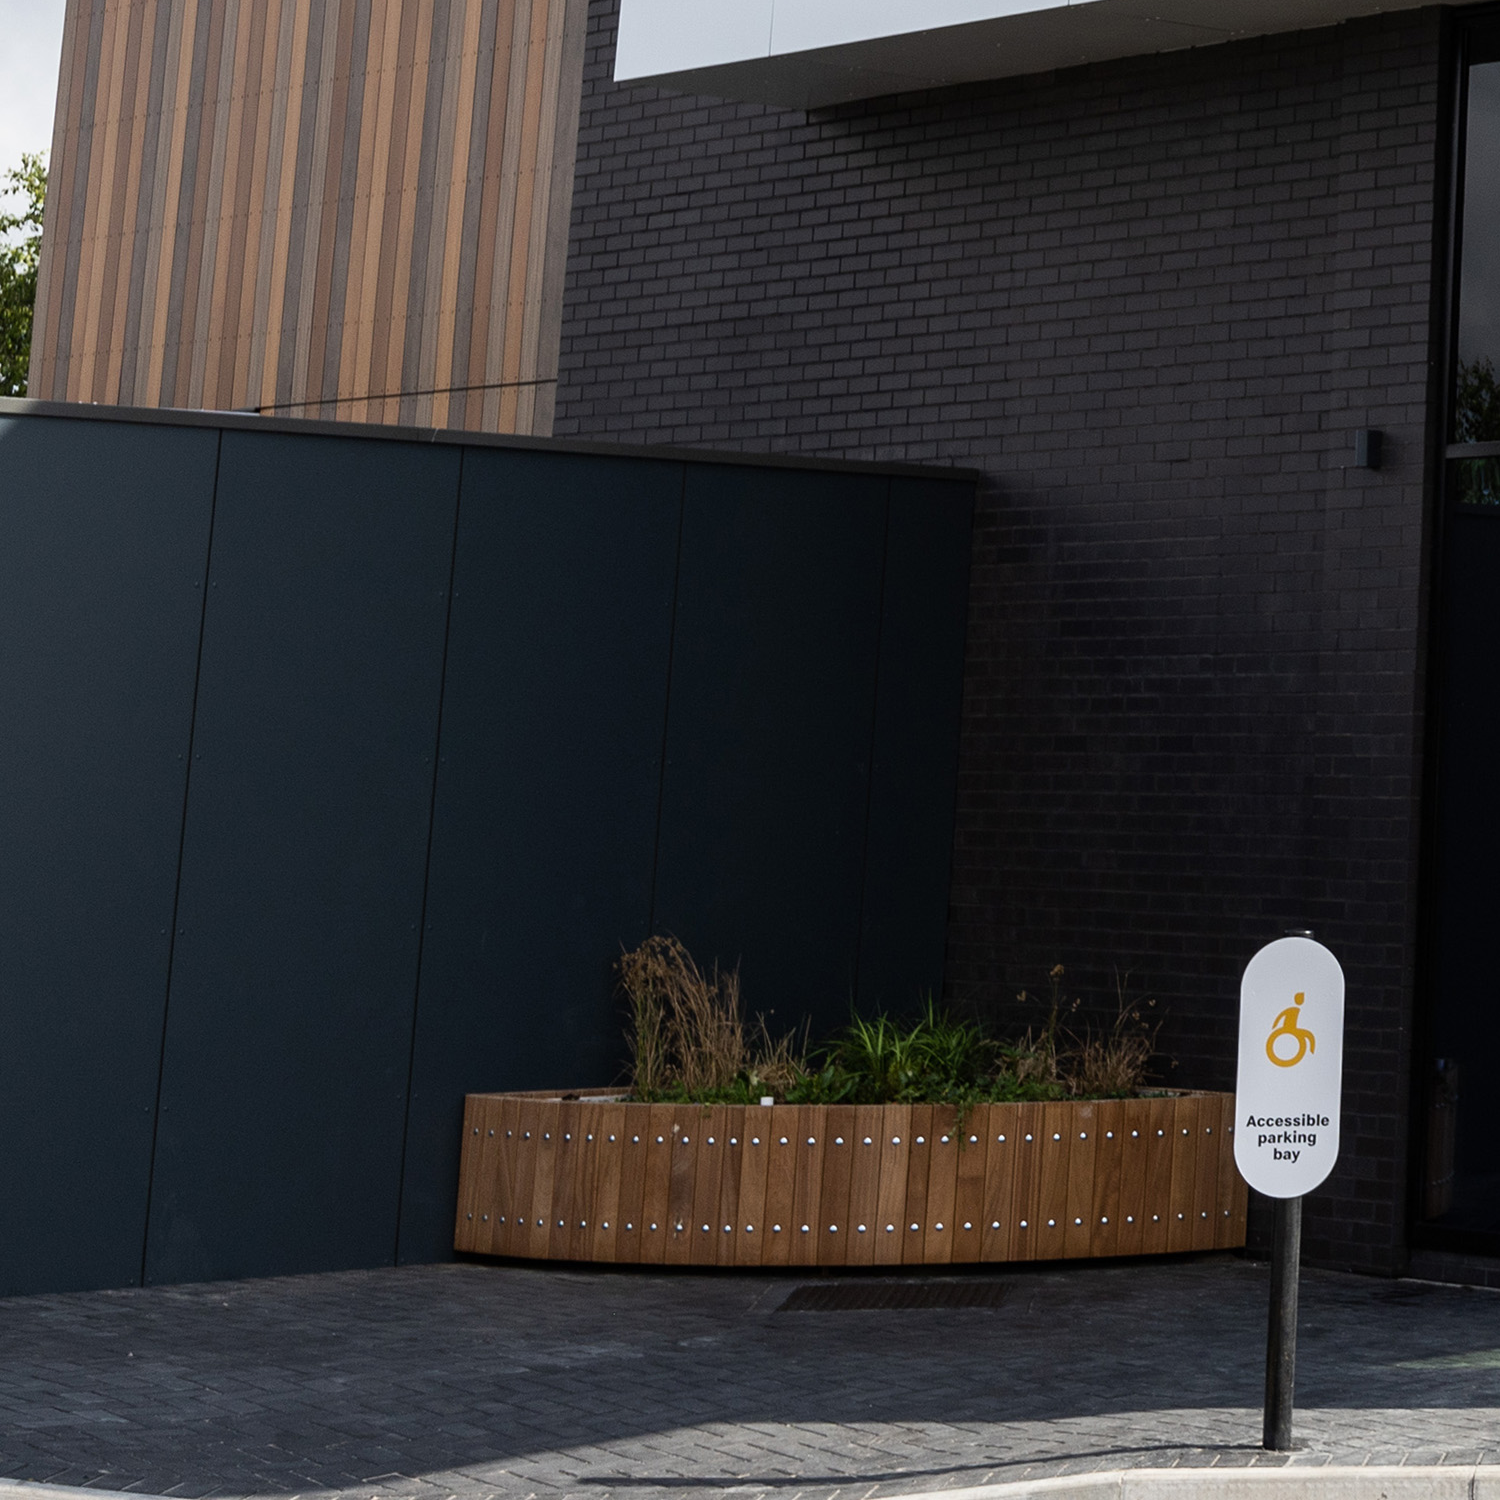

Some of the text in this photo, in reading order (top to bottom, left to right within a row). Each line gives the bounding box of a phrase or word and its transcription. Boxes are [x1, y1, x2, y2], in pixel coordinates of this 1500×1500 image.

[1246, 1114, 1330, 1128] Accessible
[1258, 1130, 1317, 1147] parking
[1273, 1147, 1301, 1163] bay
